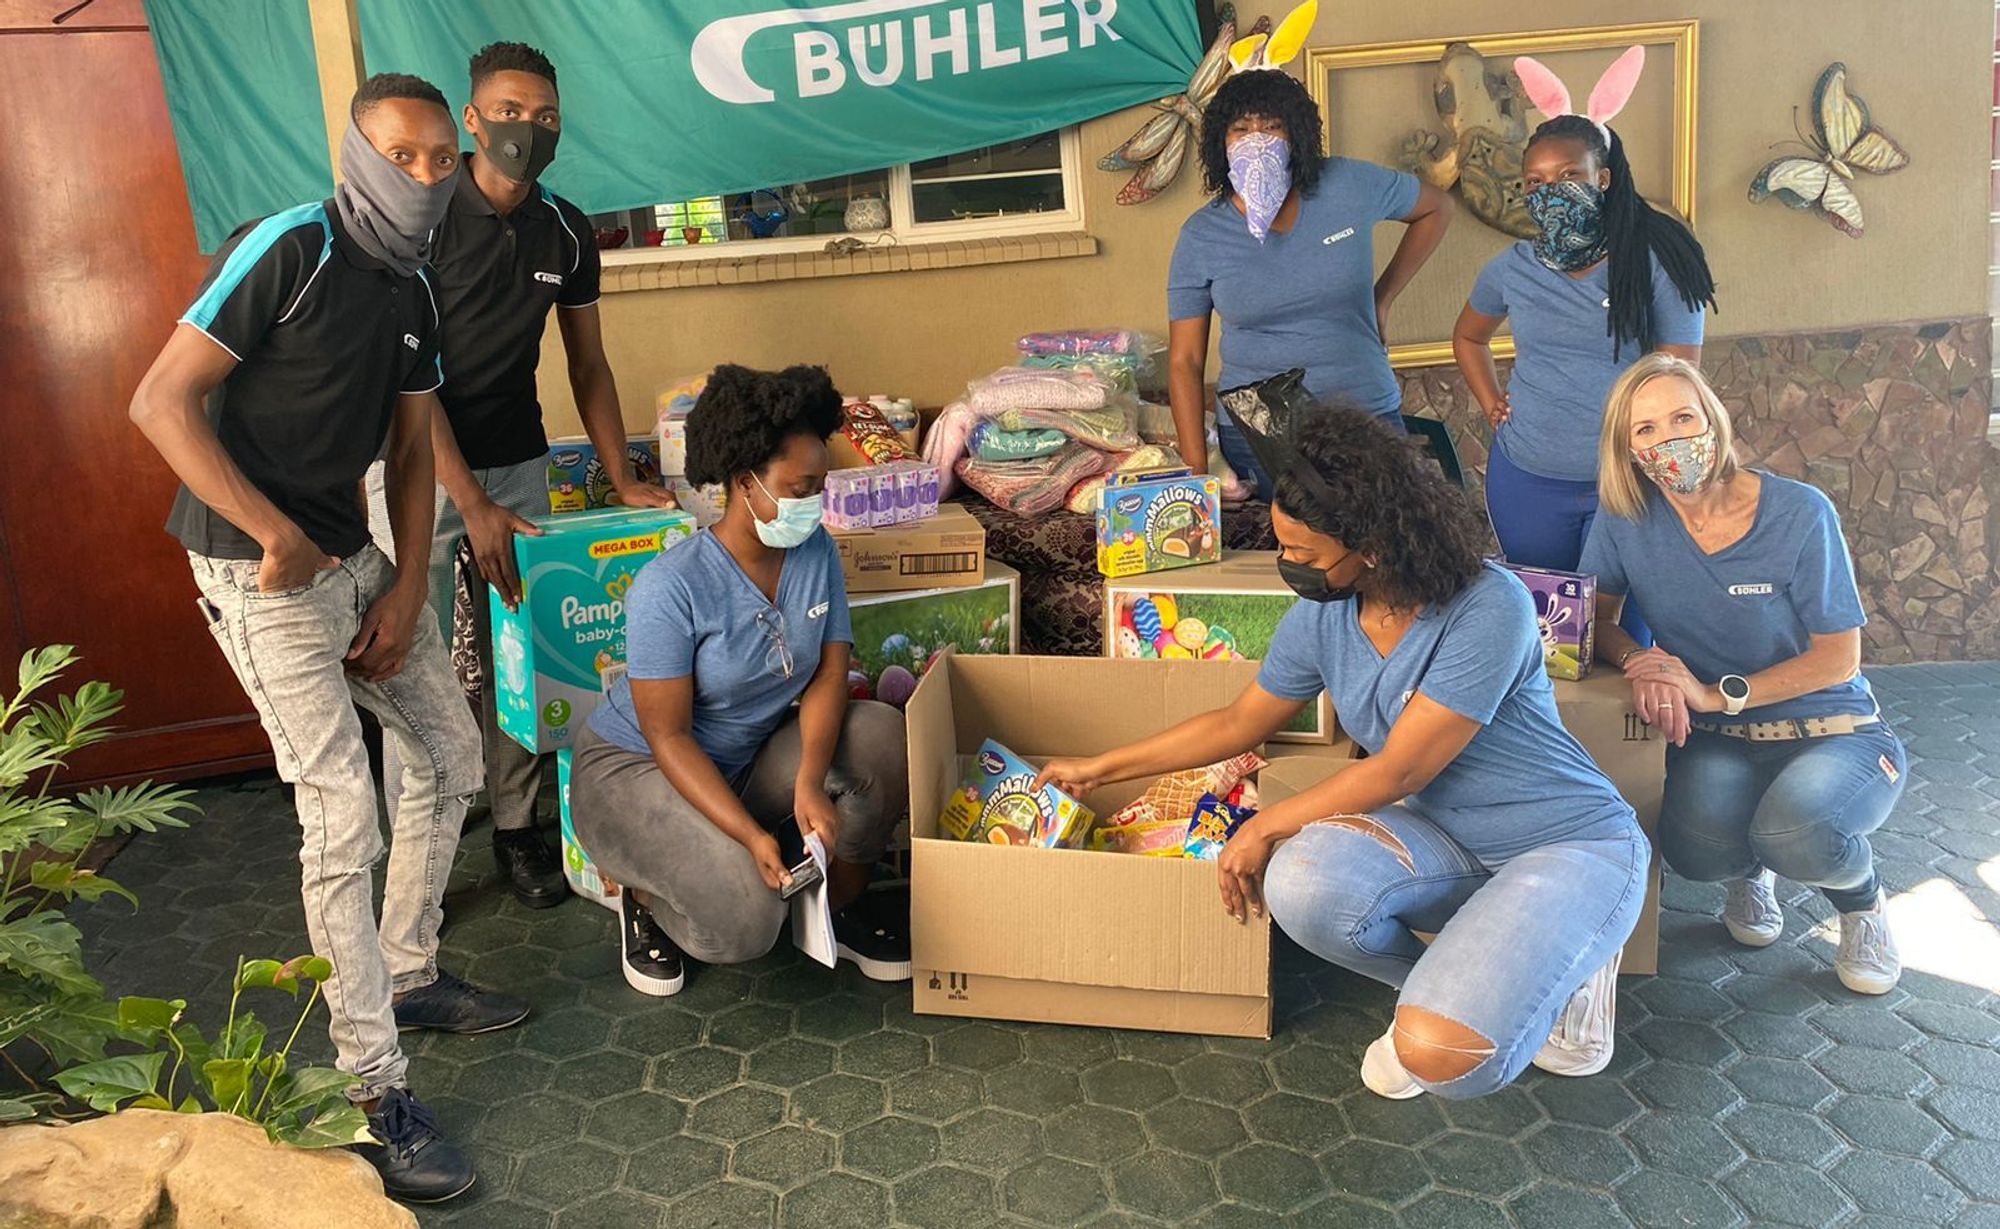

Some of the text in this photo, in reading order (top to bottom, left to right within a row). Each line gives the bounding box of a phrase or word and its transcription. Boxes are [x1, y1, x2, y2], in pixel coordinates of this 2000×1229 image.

[793, 0, 1122, 98] BÜHLER
[594, 538, 654, 555] MEGA BOX
[560, 596, 625, 630] Pamp
[551, 700, 563, 718] 3
[570, 847, 579, 864] 4
